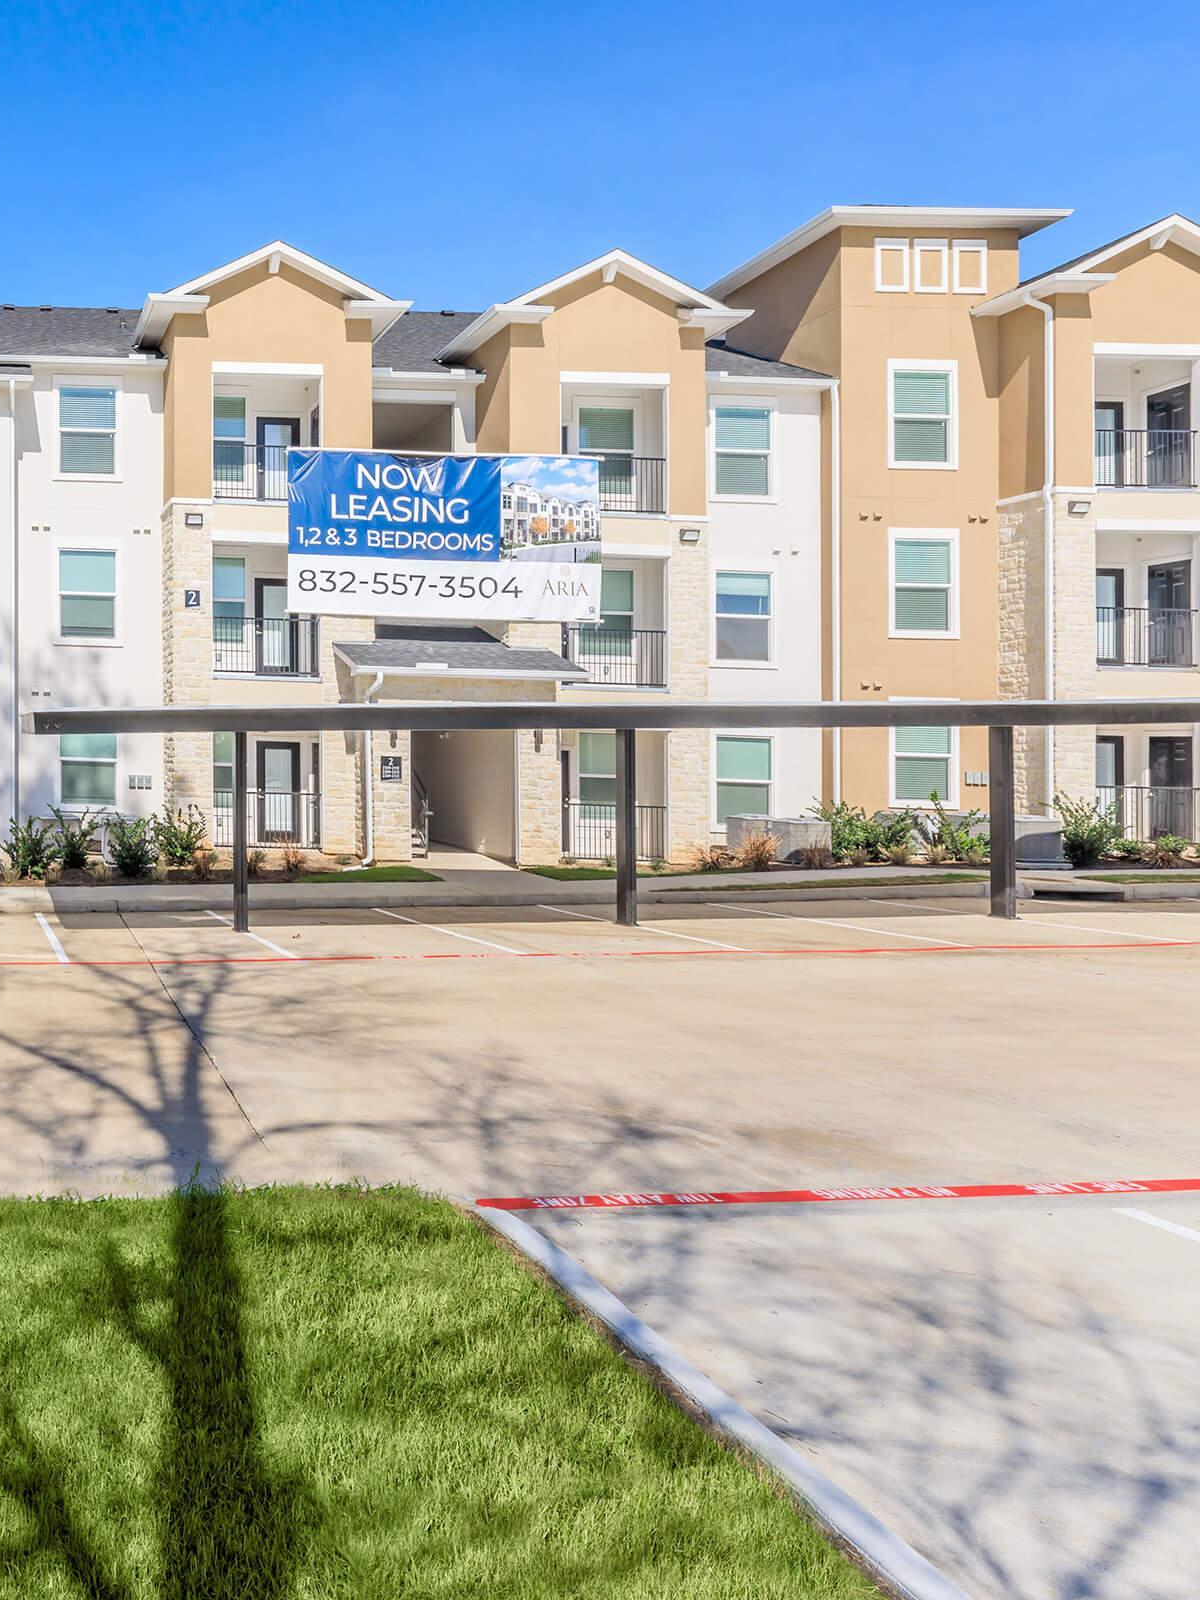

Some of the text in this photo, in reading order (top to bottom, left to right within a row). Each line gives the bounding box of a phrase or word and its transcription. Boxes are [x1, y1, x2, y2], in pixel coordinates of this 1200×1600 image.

[356, 463, 443, 492] NOW
[330, 493, 469, 524] LEASING
[343, 528, 358, 546] 3
[366, 529, 494, 552] BEDROOMS
[298, 568, 523, 599] 832-557-3504
[542, 579, 589, 597] ARIA
[187, 591, 198, 606] 2
[810, 1186, 961, 1200] NO PARKING
[1024, 1183, 1093, 1194] LANE
[599, 1194, 664, 1206] AWAY
[673, 1192, 724, 1204] TOW
